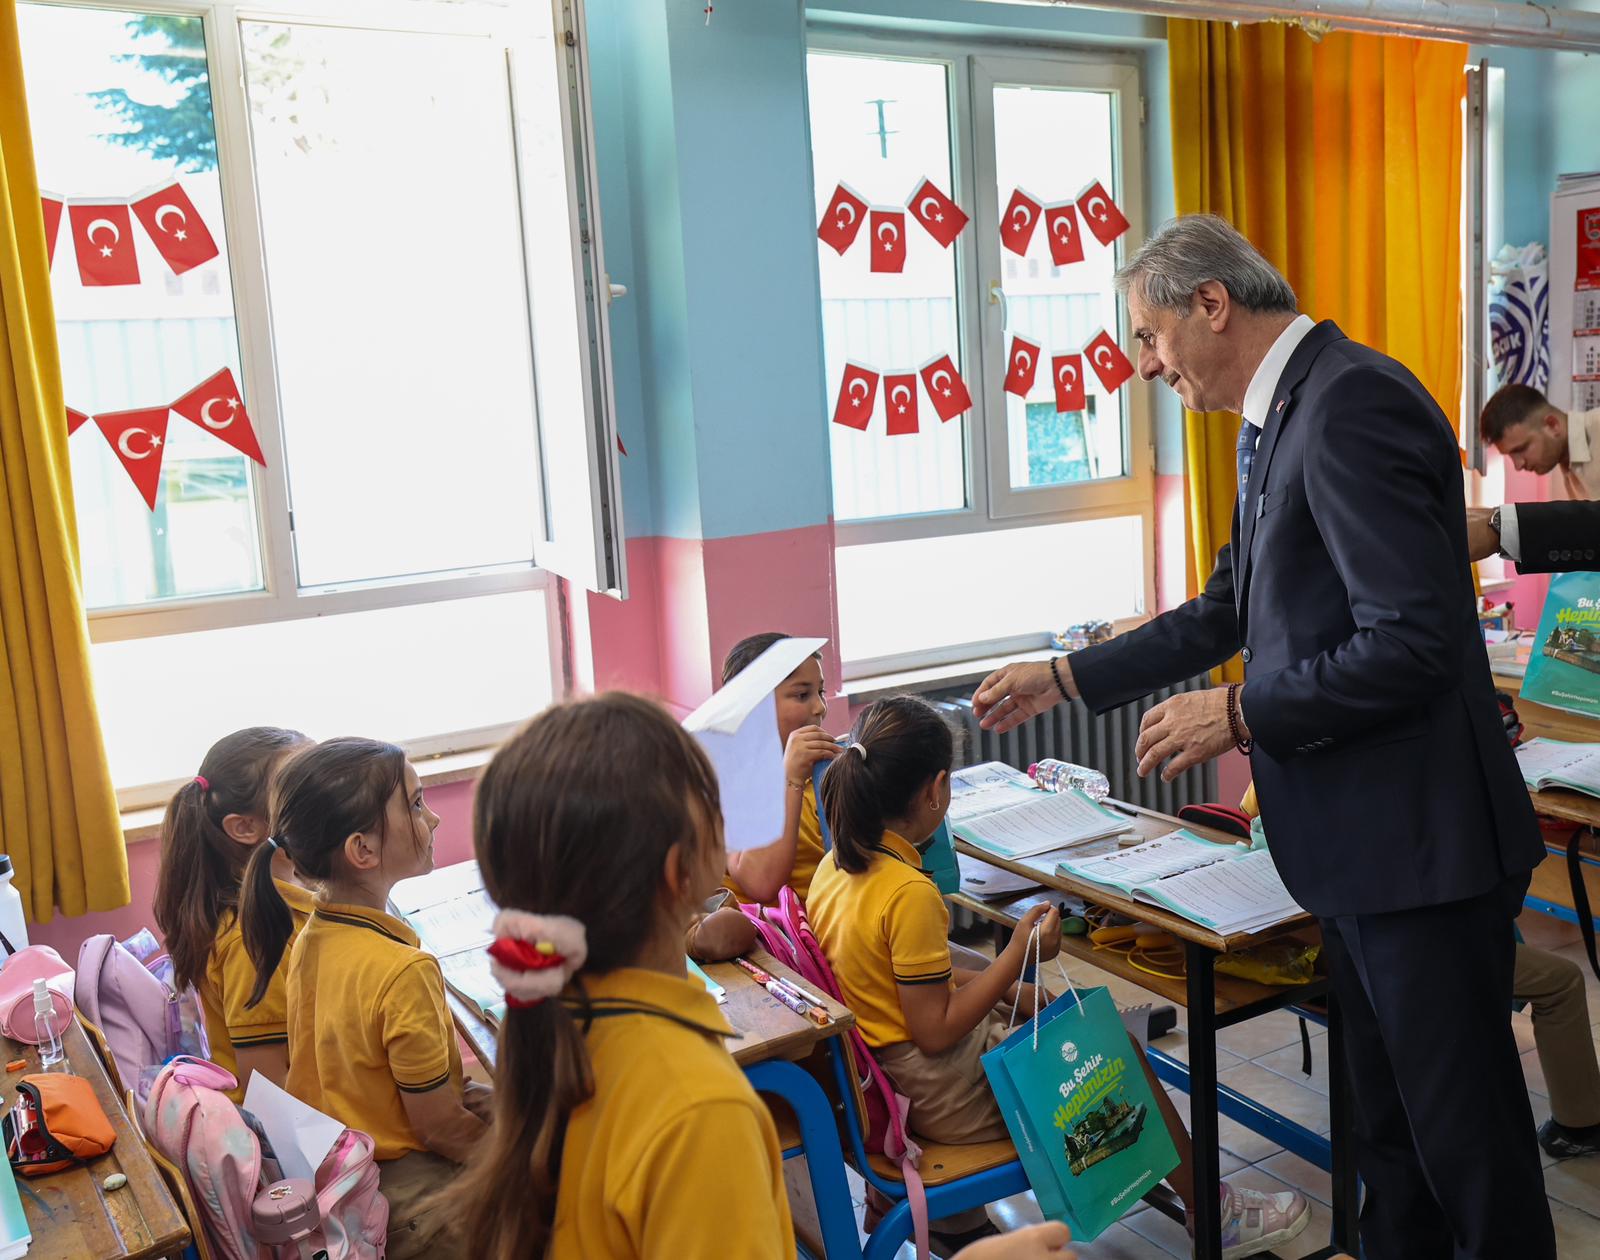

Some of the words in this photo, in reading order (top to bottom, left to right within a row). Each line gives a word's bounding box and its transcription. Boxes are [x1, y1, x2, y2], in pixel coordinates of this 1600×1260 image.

[1577, 597, 1593, 608] Bu
[1054, 1057, 1126, 1131] Hepimizin
[1059, 1079, 1076, 1098] Bu
[1073, 1053, 1103, 1086] Şehir
